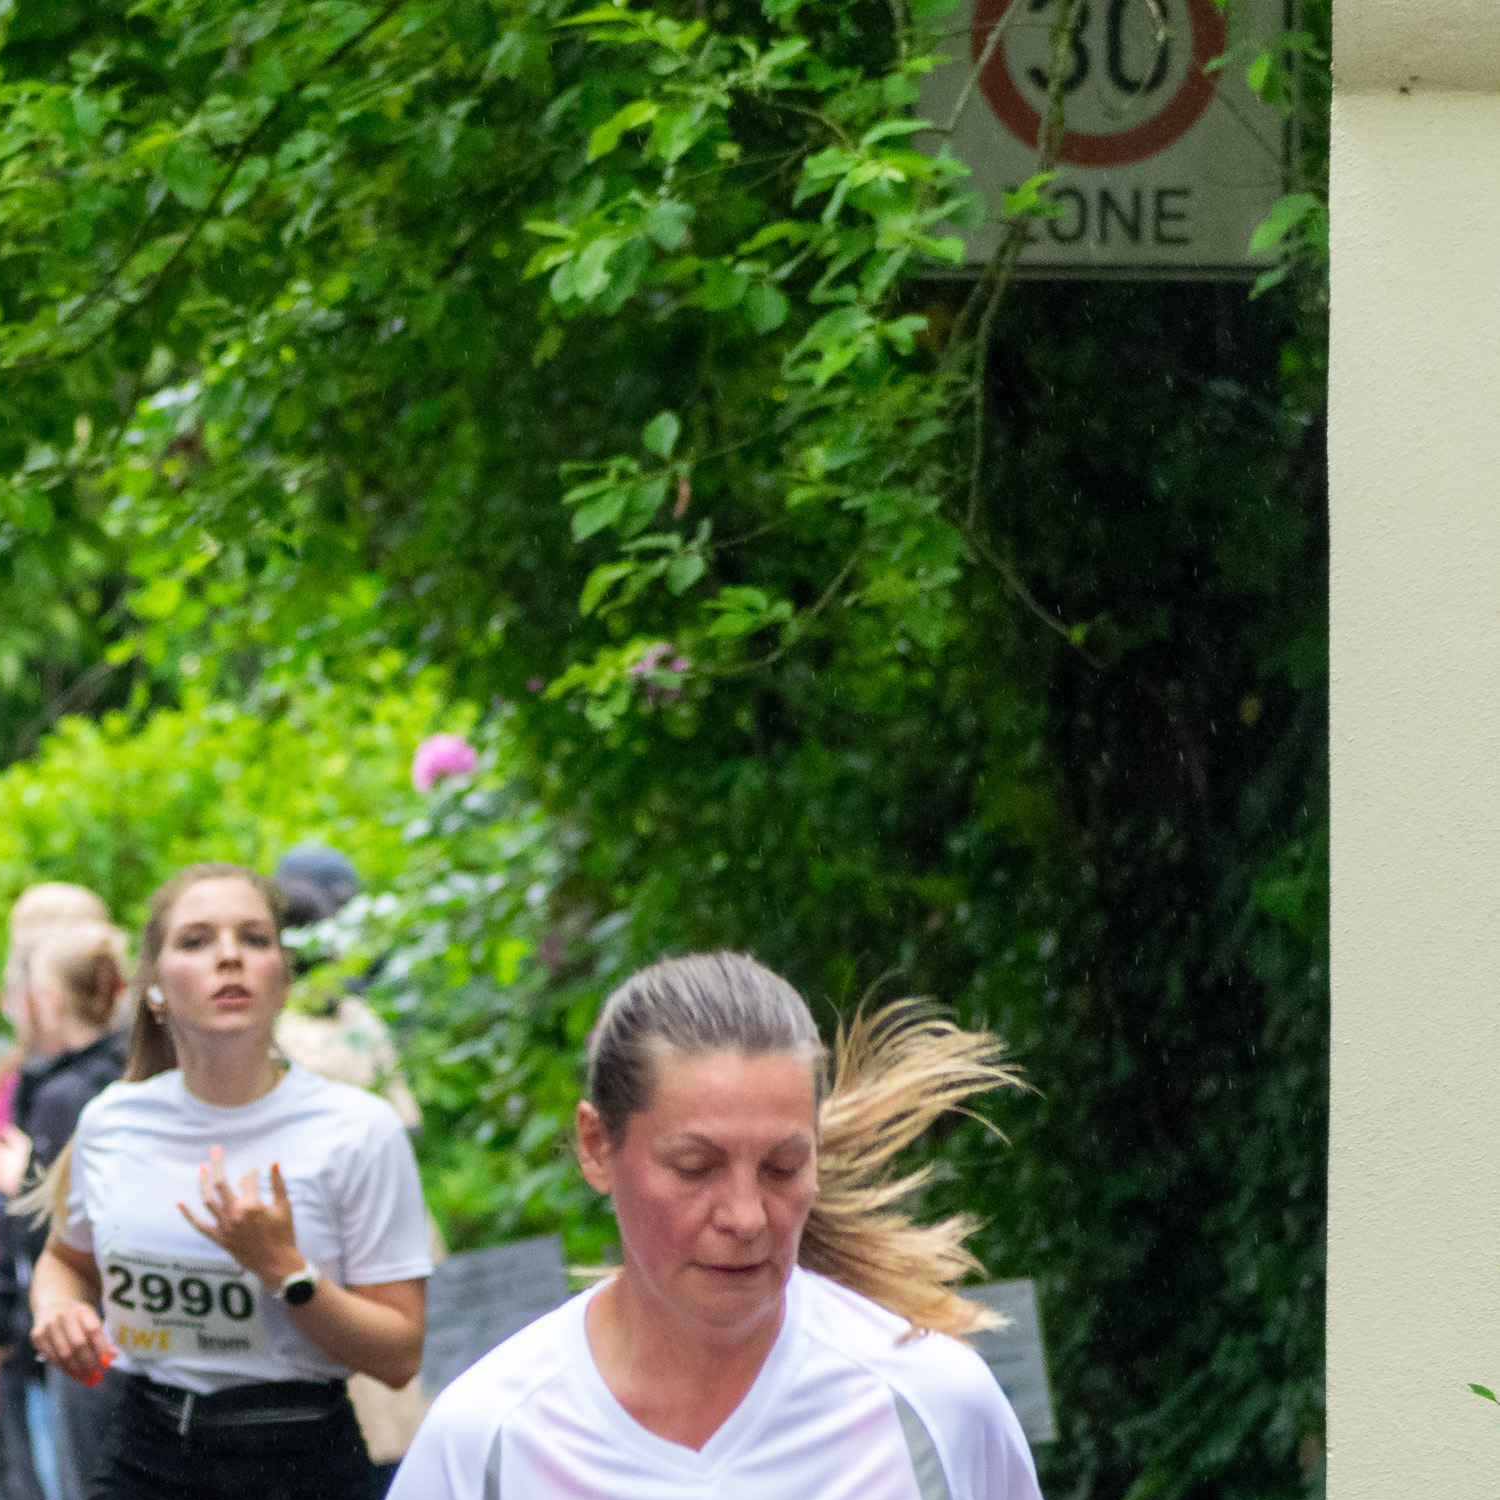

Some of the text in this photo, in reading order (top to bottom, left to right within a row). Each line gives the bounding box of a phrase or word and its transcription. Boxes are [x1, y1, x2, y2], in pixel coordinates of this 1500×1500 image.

[1024, 0, 1170, 95] 30
[107, 1264, 254, 1321] 2990
[117, 1324, 172, 1350] EWE
